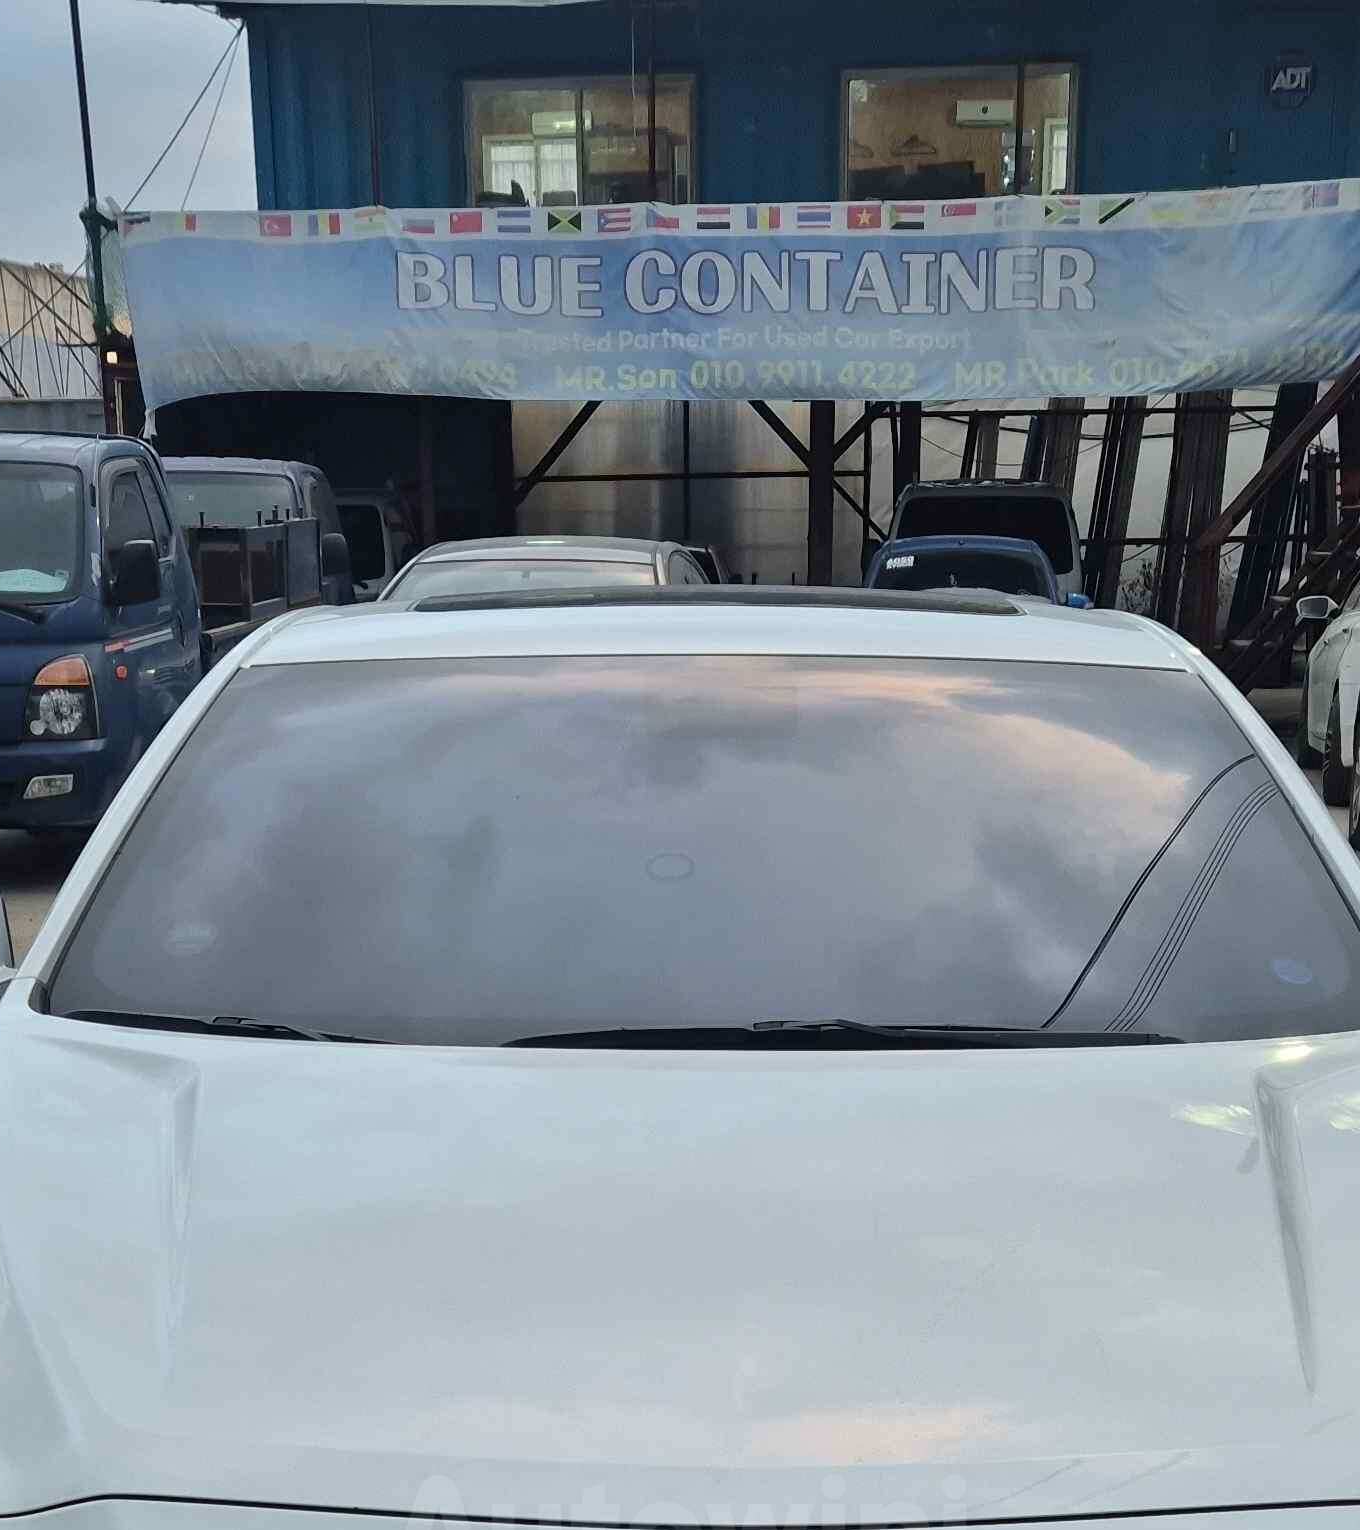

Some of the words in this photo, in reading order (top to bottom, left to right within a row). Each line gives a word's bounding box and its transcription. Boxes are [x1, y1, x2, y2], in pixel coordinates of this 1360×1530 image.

[1271, 67, 1311, 90] ADT
[396, 250, 604, 318] BLUE
[624, 247, 1096, 316] CONTAINER
[618, 327, 710, 351] Partner
[718, 328, 758, 349] For
[764, 325, 828, 349] Used
[835, 327, 878, 349] Car
[891, 328, 971, 353] Export
